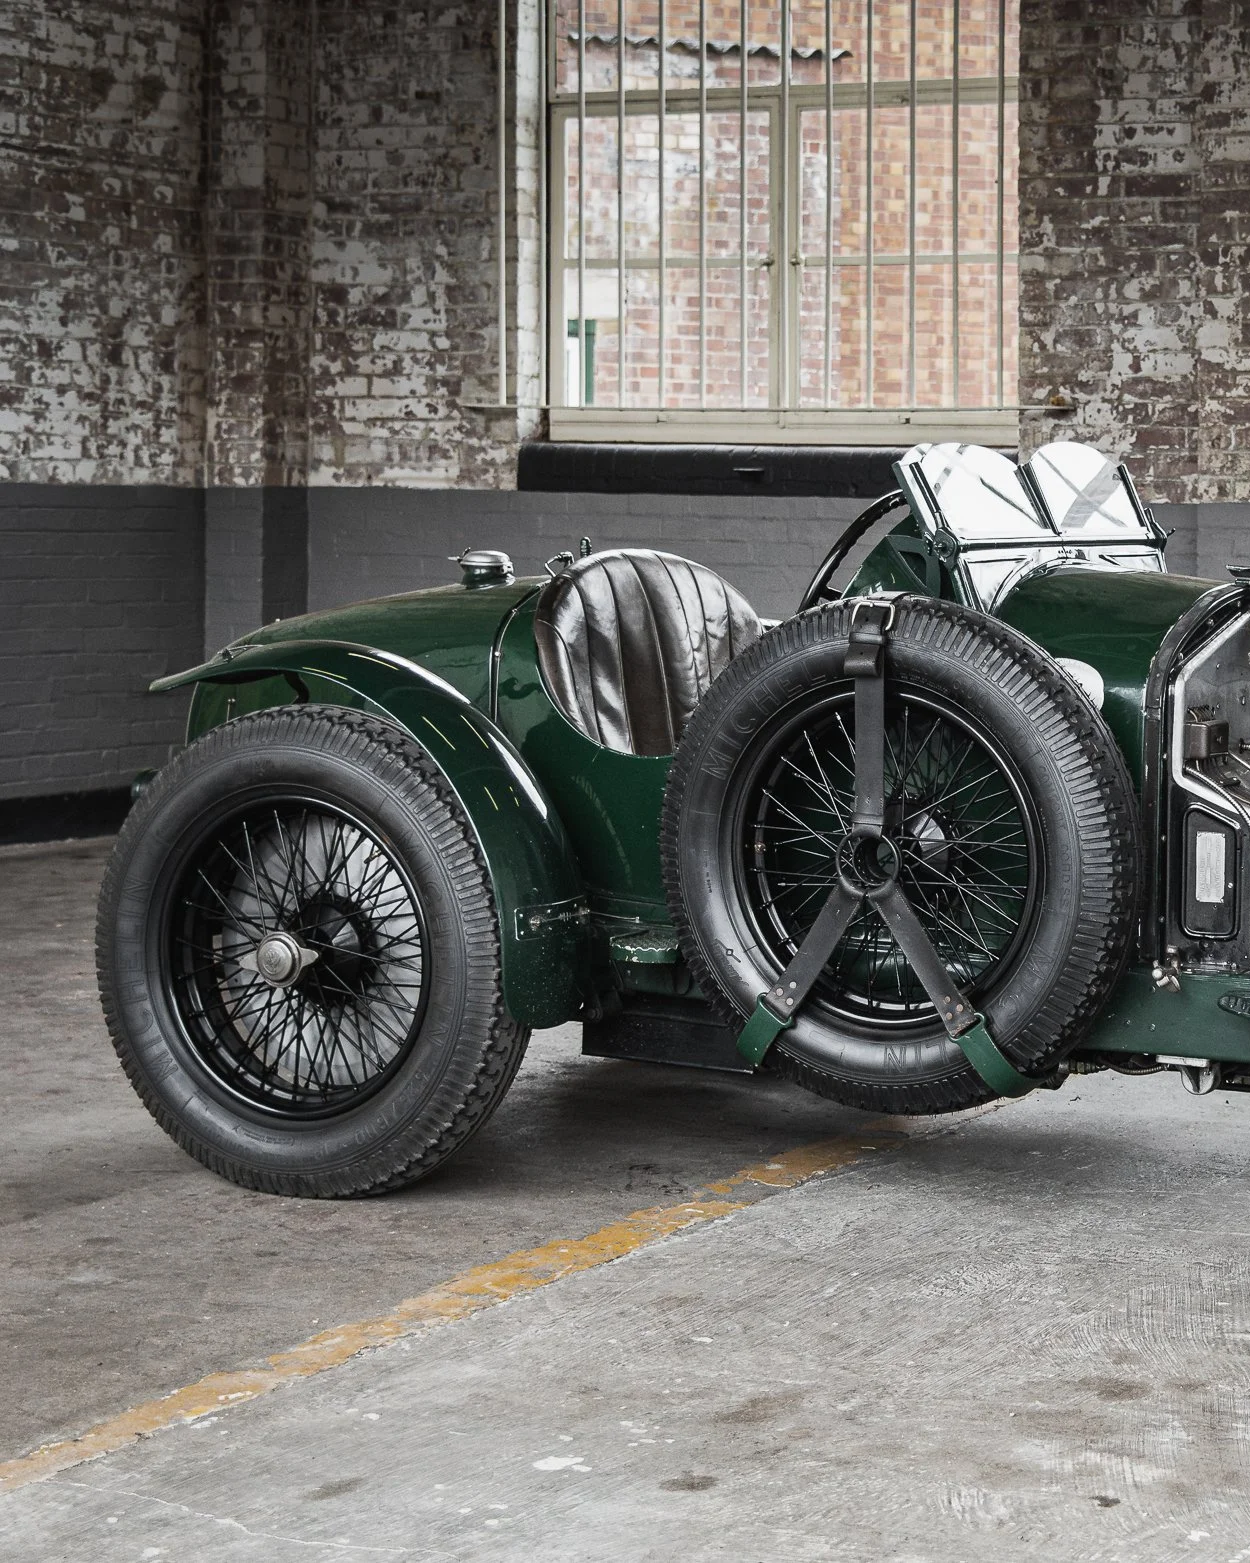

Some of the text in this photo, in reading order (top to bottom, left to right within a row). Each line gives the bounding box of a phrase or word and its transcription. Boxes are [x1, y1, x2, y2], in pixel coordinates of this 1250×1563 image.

[700, 658, 835, 781] MICHEL
[114, 874, 179, 1086] MICHELIN
[395, 828, 455, 1049] MICHELIN
